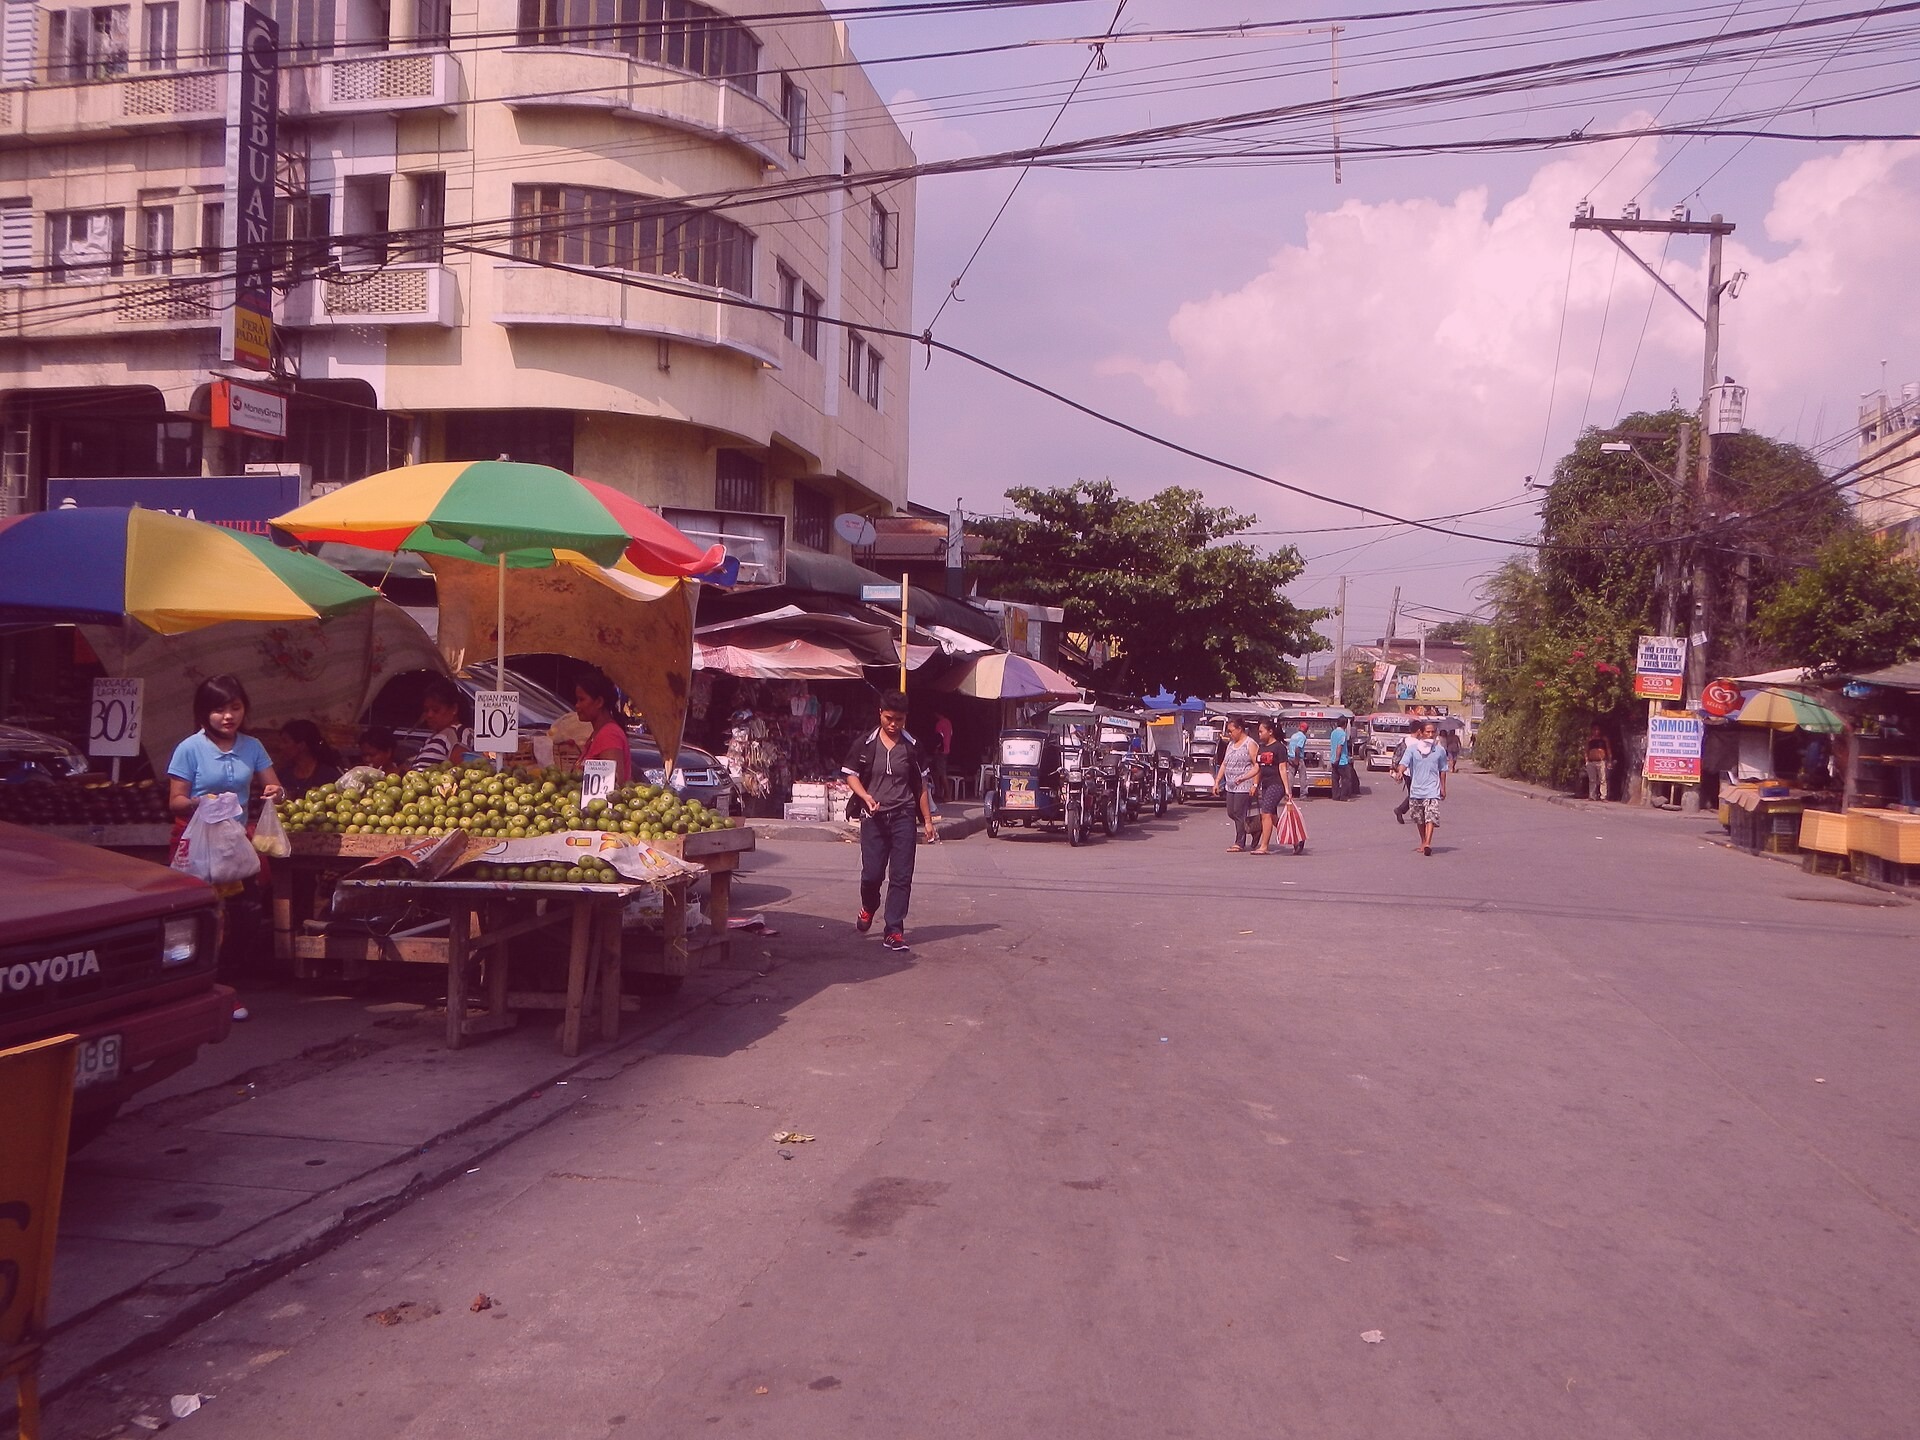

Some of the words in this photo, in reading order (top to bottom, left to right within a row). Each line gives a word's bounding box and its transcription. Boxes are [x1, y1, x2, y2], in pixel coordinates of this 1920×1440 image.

[244, 25, 275, 294] CEBUANA
[242, 319, 264, 336] PERA
[1656, 647, 1678, 655] ENTRY
[1660, 654, 1682, 662] RIGHT
[1643, 660, 1659, 668] THIS
[1661, 661, 1677, 669] WAY
[89, 699, 127, 742] 30
[476, 708, 509, 738] 10
[1651, 719, 1699, 733] SMMODA
[1009, 777, 1029, 792] 27
